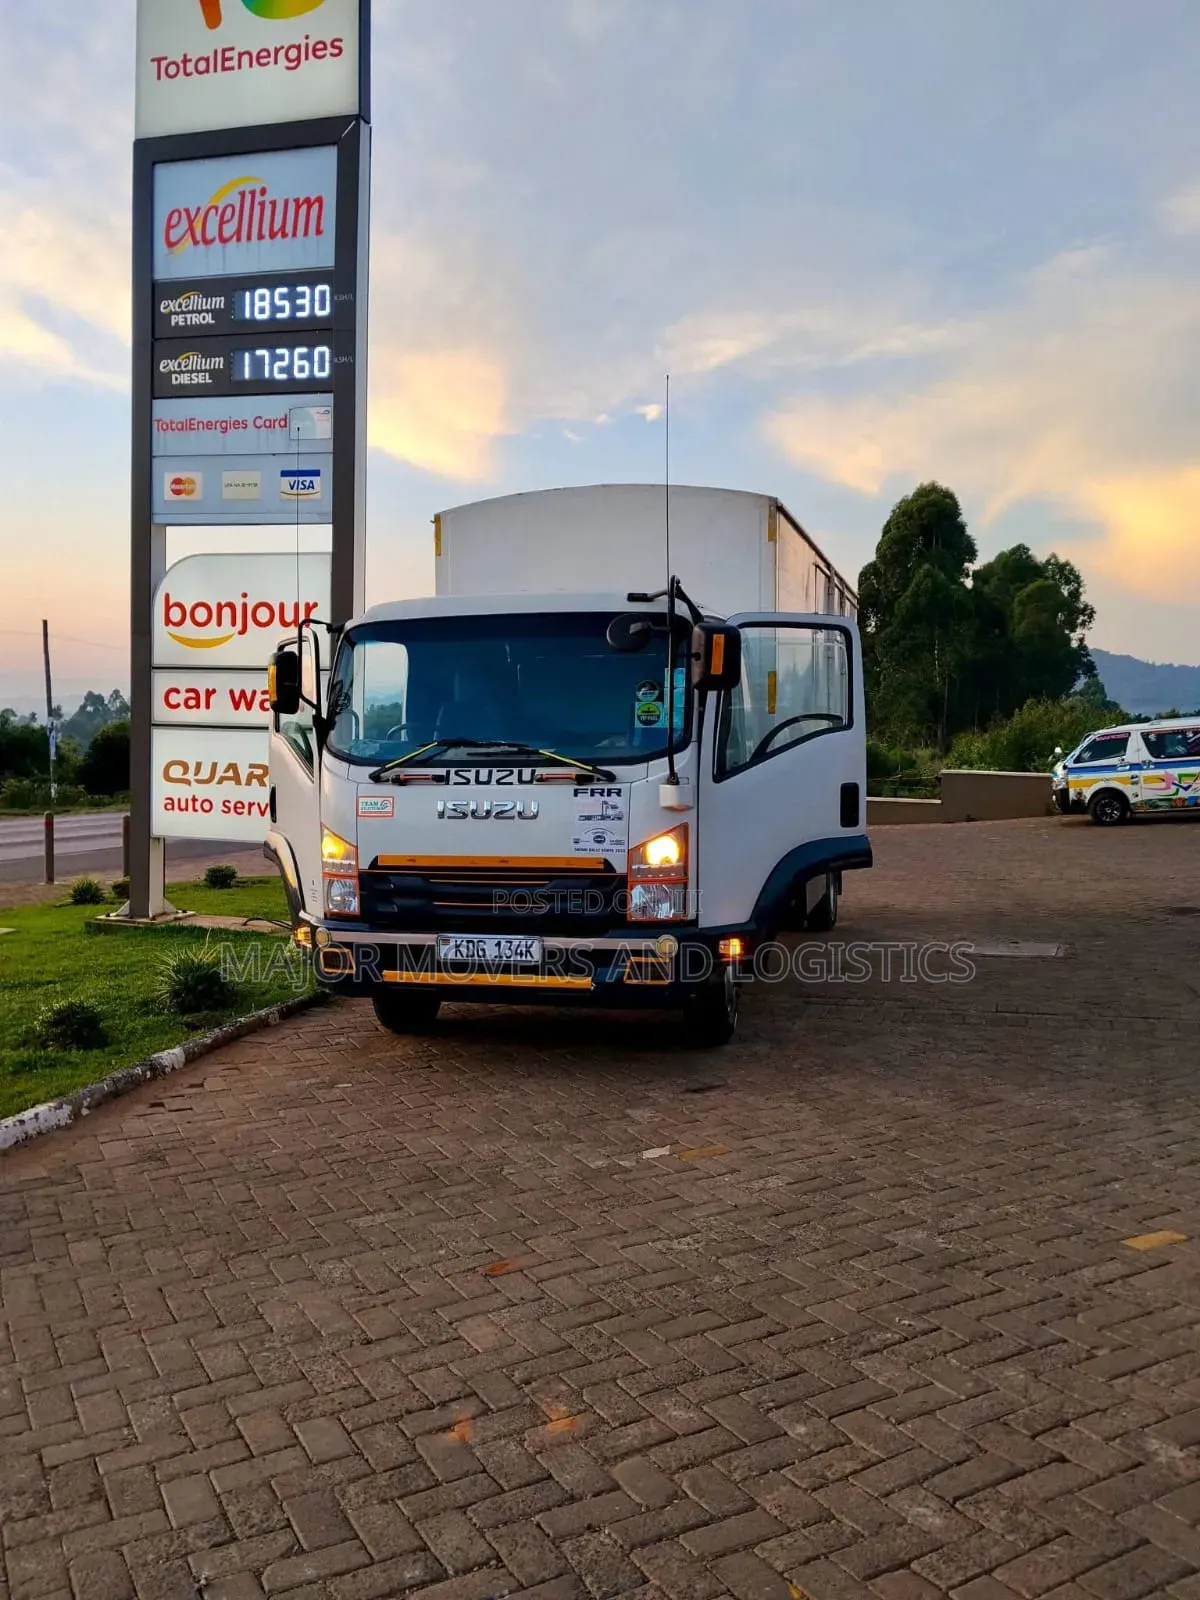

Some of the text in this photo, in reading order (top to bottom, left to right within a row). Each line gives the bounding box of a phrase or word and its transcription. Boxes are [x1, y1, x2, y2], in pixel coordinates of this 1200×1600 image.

[151, 35, 344, 81] TotalEnergies
[164, 186, 324, 250] excellium
[160, 294, 225, 313] excellium
[244, 284, 331, 320] 18530
[171, 312, 215, 326] PETROL
[159, 355, 224, 373] excellium
[244, 346, 331, 380] 17260
[171, 373, 212, 385] DIESEL
[154, 414, 288, 434] TotalEnergies Card
[288, 480, 315, 490] VISA
[163, 592, 318, 636] bonjour
[163, 687, 217, 710] car
[162, 760, 269, 787] QUAR
[444, 769, 536, 786] ISUZU
[573, 788, 622, 798] FRR
[164, 794, 269, 818] auto serv
[437, 800, 539, 820] ISUZU
[454, 939, 534, 960] KDG 134K
